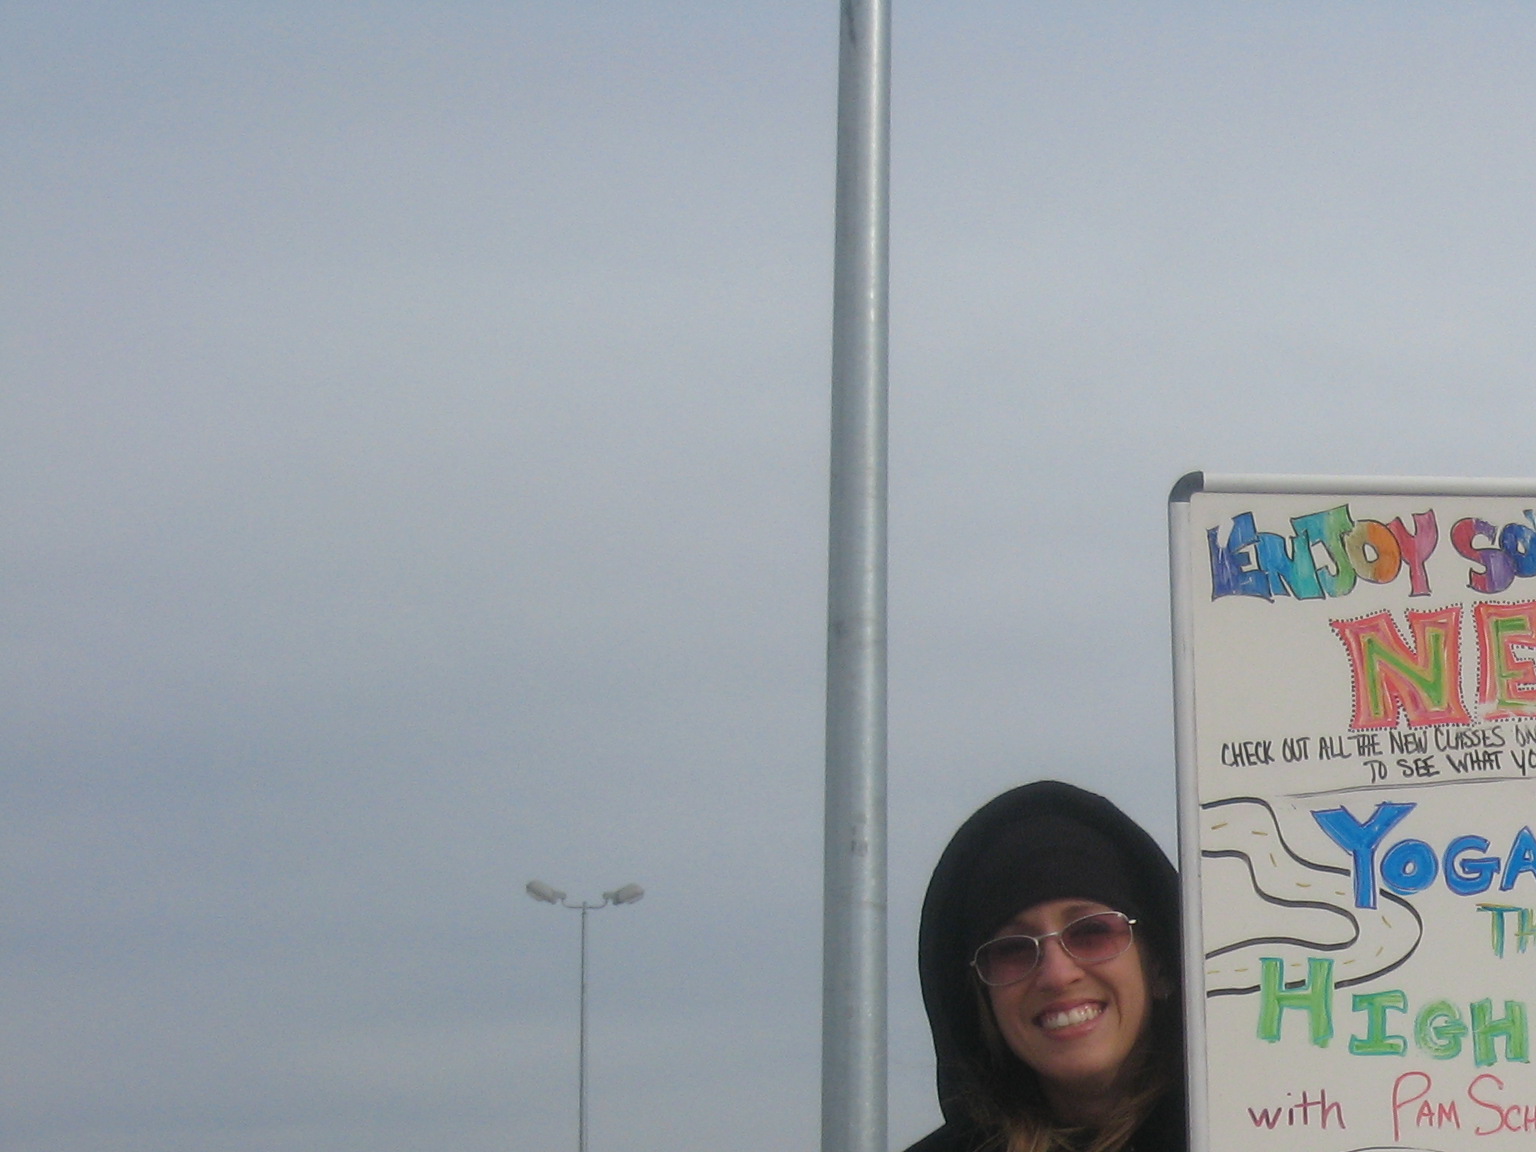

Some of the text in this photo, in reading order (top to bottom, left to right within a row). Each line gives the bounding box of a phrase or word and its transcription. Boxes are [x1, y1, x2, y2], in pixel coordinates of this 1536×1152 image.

[1207, 504, 1437, 601] ENJOY
[1221, 740, 1275, 767] CHECK
[1282, 737, 1310, 762] OUT
[1319, 735, 1352, 760] ALL
[1348, 733, 1383, 757] THE
[1390, 731, 1428, 755] NEW
[1435, 726, 1505, 751] CLASSES
[1363, 760, 1387, 783] TO
[1401, 757, 1440, 777] SEE
[1447, 751, 1503, 773] WHAT
[1248, 1092, 1346, 1131] with
[1391, 1071, 1460, 1142] PAM
